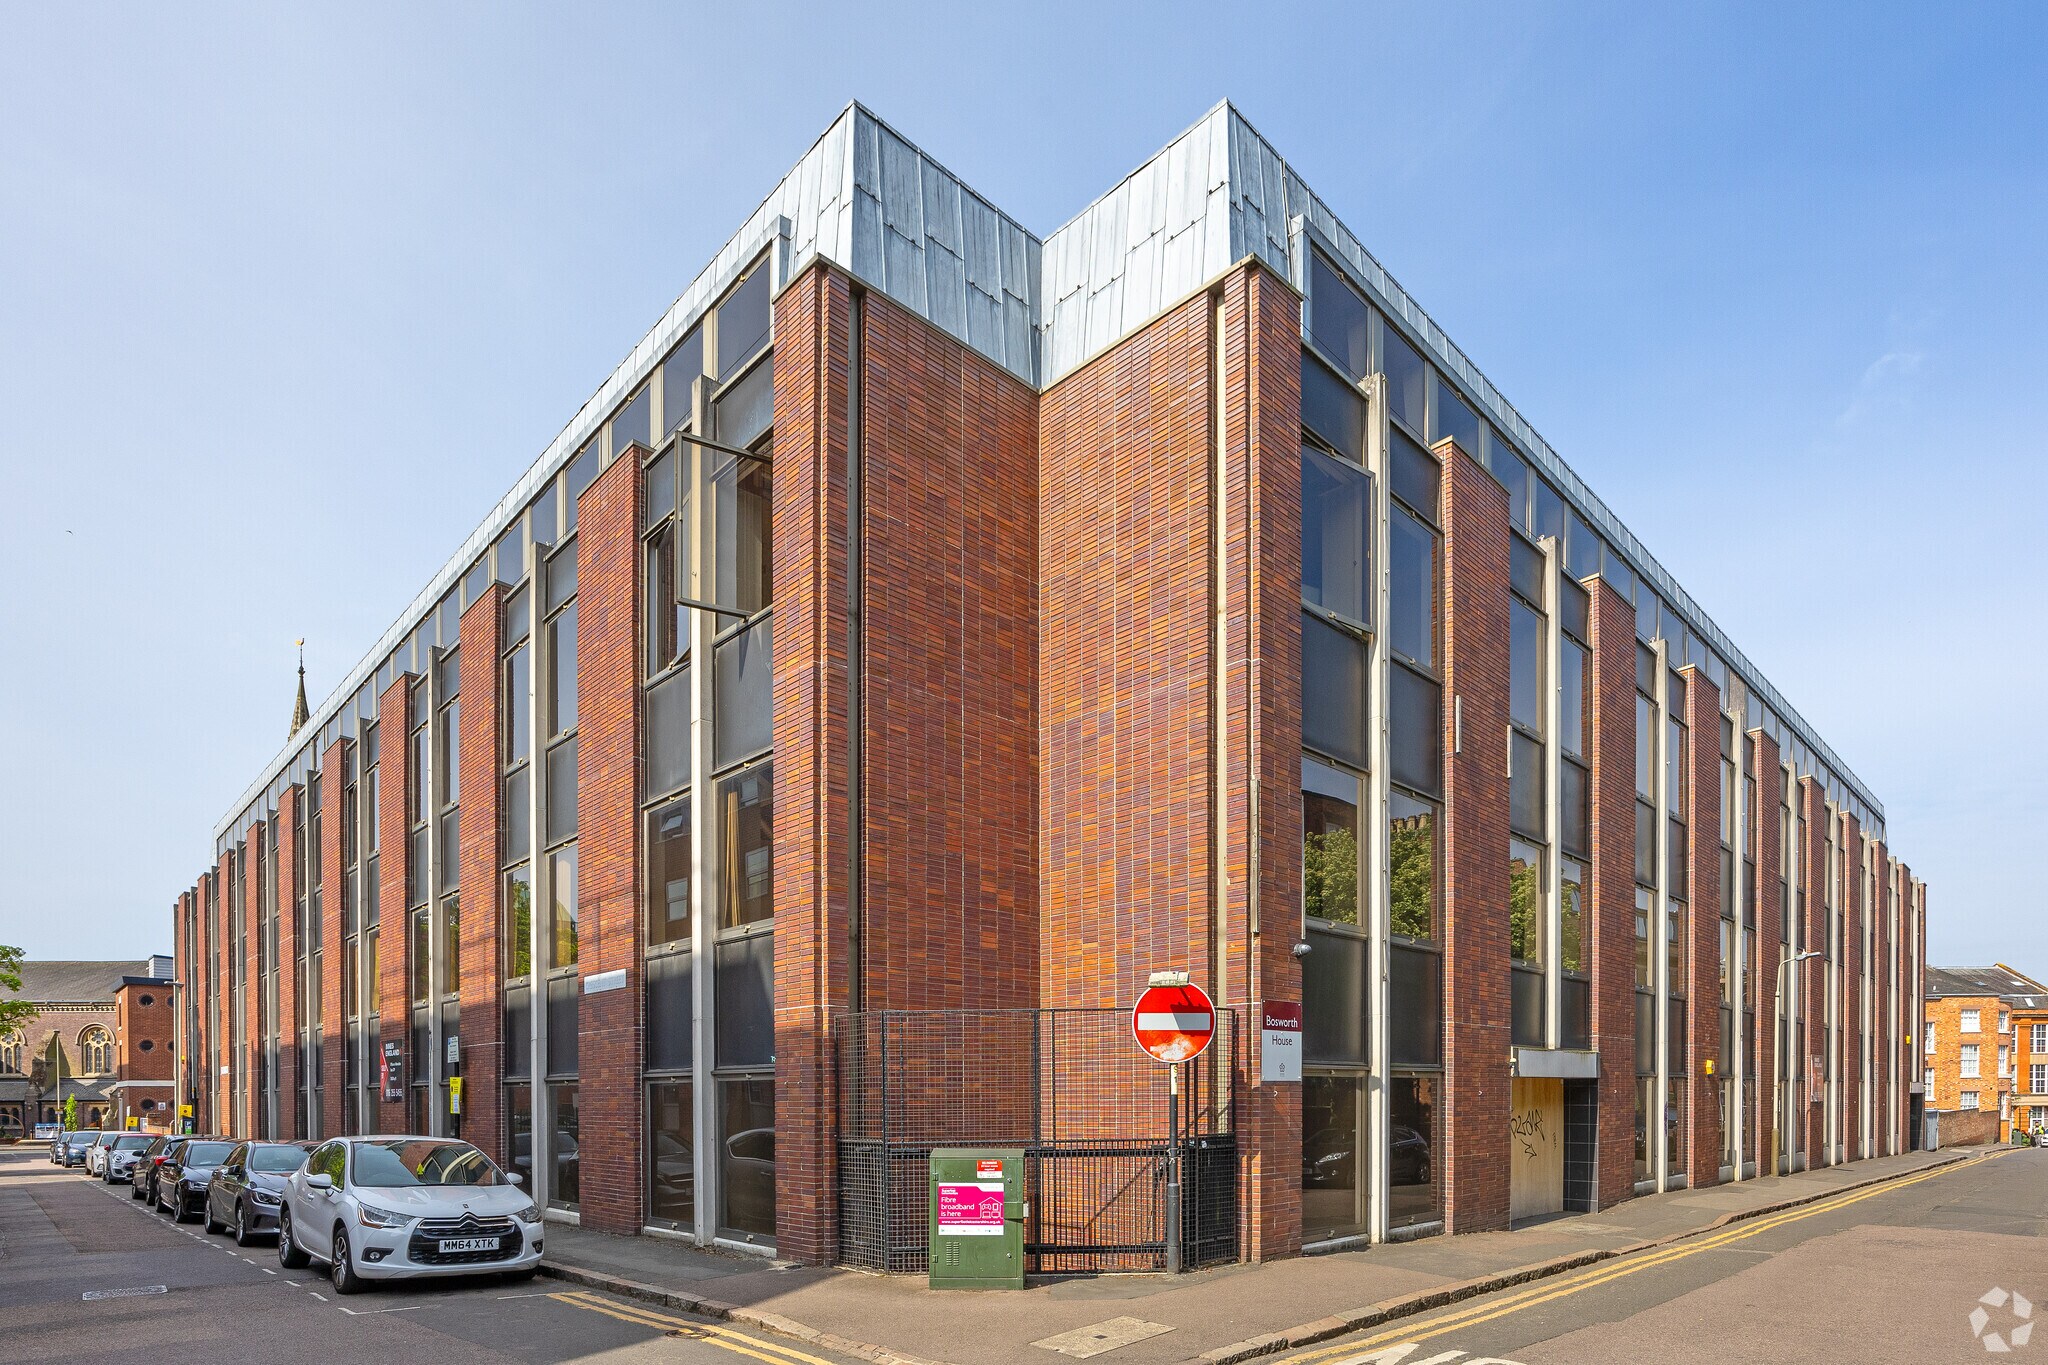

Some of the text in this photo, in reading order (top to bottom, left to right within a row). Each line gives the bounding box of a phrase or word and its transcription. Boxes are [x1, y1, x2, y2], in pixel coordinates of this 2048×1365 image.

[1266, 1015, 1298, 1028] Bosworth
[1272, 1035, 1292, 1046] House
[444, 1239, 494, 1250] MM64 XTK
